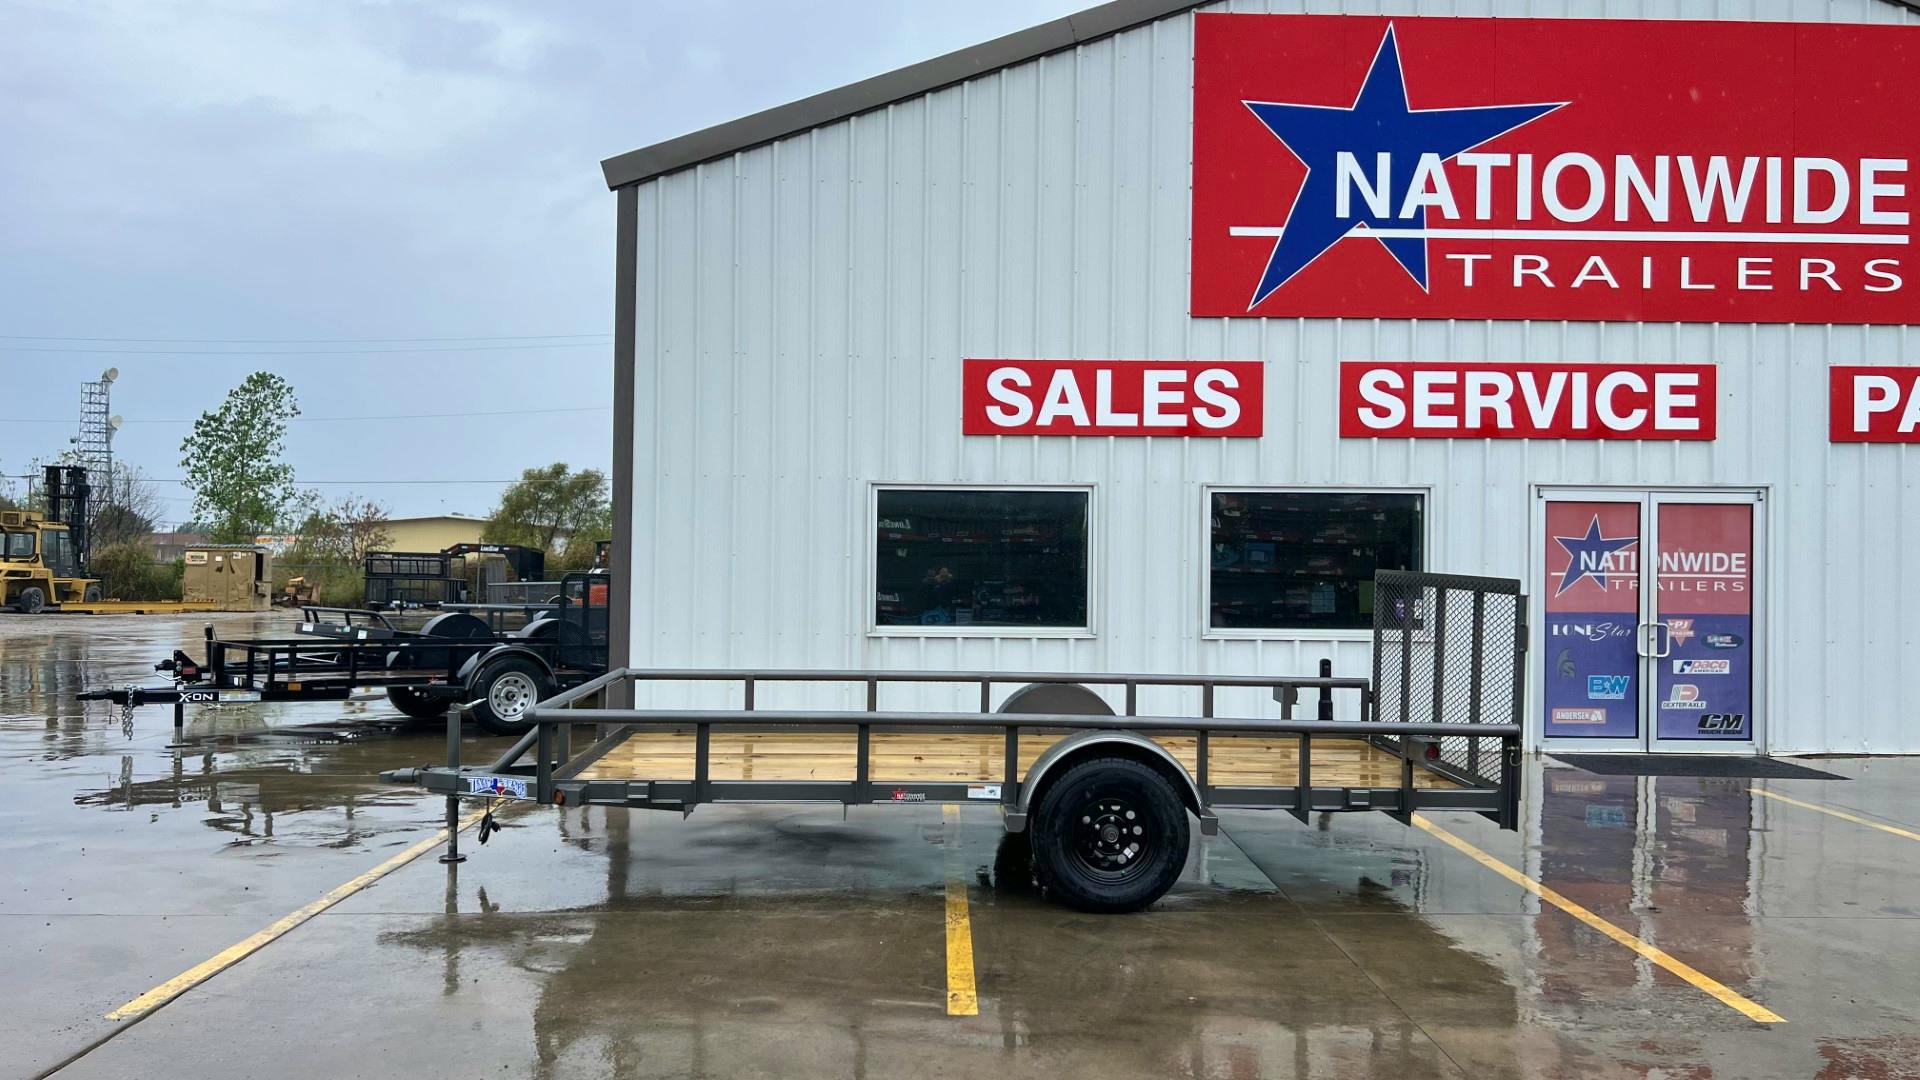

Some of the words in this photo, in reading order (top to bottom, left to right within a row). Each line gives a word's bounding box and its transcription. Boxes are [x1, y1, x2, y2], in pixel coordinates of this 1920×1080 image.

[1334, 151, 1910, 226] NATIONWIDE
[1445, 253, 1903, 292] TRAILERS
[985, 366, 1242, 429] SALES
[1357, 368, 1701, 431] SERVICE
[1580, 550, 1746, 573] NATINWIDE
[1556, 711, 1590, 720] ANDERSEN
